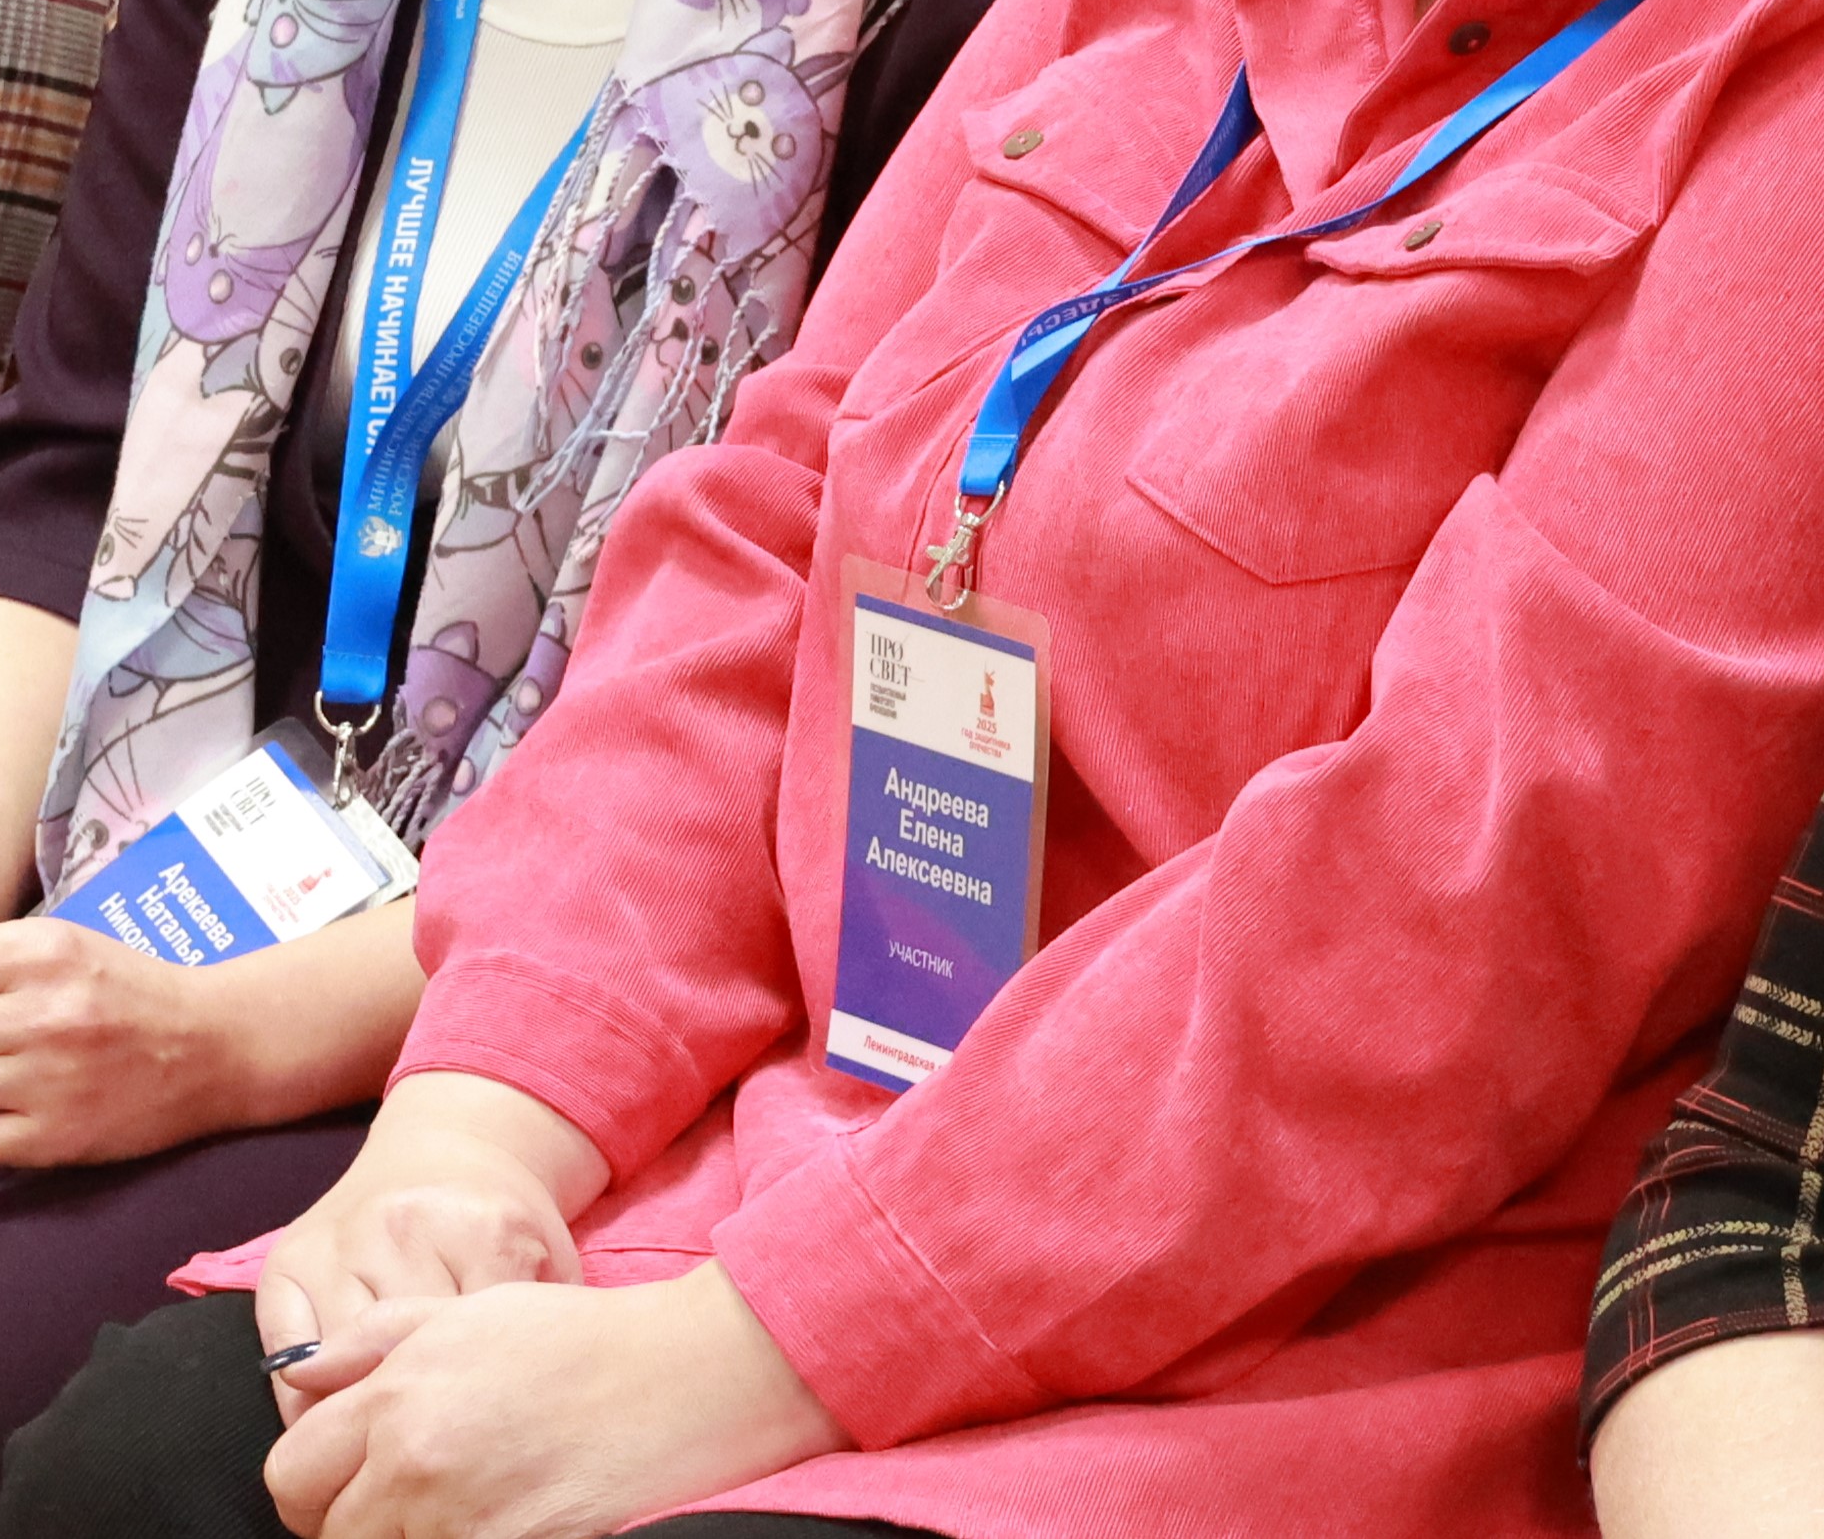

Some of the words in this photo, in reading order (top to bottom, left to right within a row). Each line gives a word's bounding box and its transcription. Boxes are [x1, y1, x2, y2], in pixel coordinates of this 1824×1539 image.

[388, 157, 434, 268] ЛУЧШЕЕ
[434, 249, 523, 382] ПРОСВЕЩЕНИЯ
[870, 632, 905, 662] ПРО
[869, 658, 912, 688] СВЕТ
[976, 716, 998, 735] 2025
[229, 789, 268, 826] СВЕТ
[245, 775, 277, 809] ПРО
[884, 767, 990, 829] Андреева
[899, 808, 965, 859] Елена
[865, 836, 993, 906] Алексеевна
[97, 891, 165, 962] Никола
[135, 884, 205, 968] Наталья
[157, 861, 236, 953] Арекаева
[888, 939, 954, 980] УЧАСТНИК
[863, 1034, 936, 1073] Ленинградская
